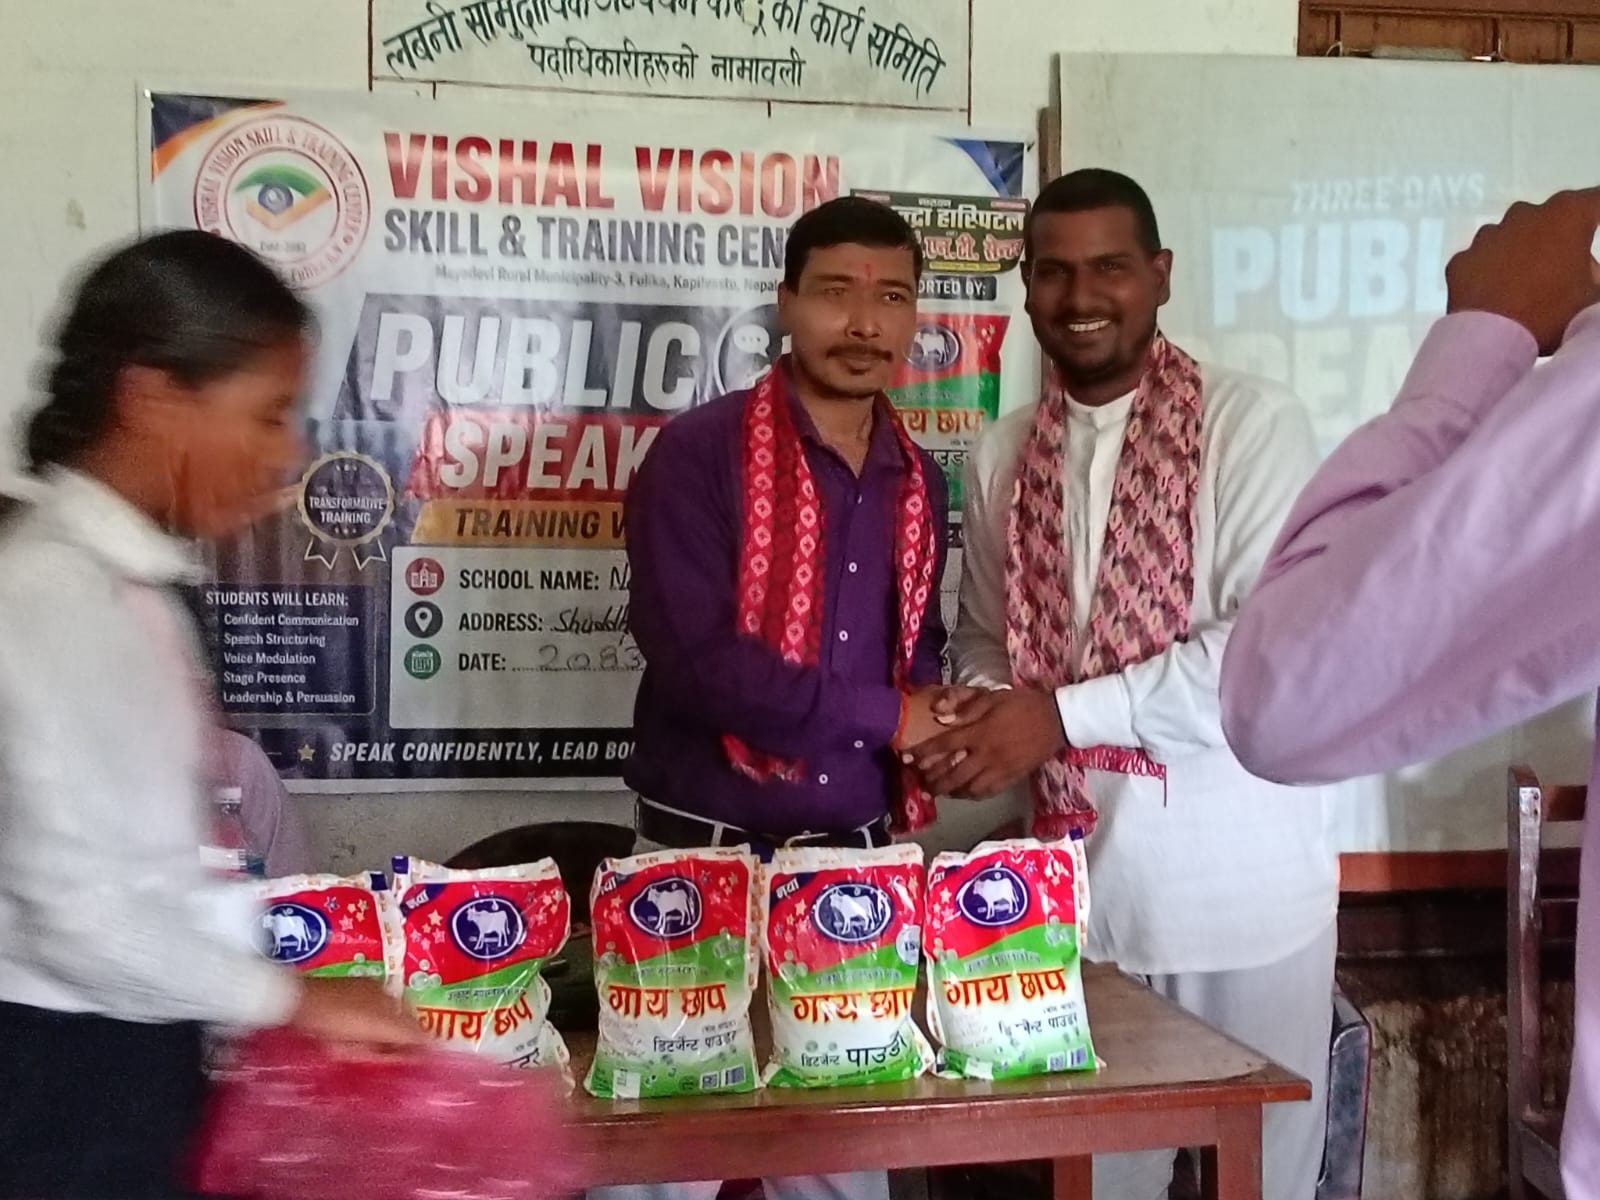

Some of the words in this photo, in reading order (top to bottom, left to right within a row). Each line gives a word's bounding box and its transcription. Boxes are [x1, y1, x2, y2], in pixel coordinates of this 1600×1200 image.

[811, 2, 866, 54] कार्य
[711, 46, 806, 88] नामावली
[383, 131, 615, 209] VISHAL
[635, 146, 840, 220] VISION
[1290, 176, 1393, 214] THREE
[1404, 172, 1486, 210] DAYS
[384, 209, 487, 256] SKILL
[500, 215, 527, 258] &
[537, 217, 706, 266] TRAINING
[717, 224, 791, 269] CEN
[370, 311, 701, 411] PUBLIC
[309, 495, 385, 510] TRANSFORMATIVE
[320, 511, 371, 524] TRAINING
[456, 508, 602, 539] TRAINING
[459, 569, 534, 590] SCHOOL
[540, 570, 599, 591] NAME:
[206, 591, 269, 606] STUDENTS
[272, 592, 302, 606] WILL
[305, 592, 349, 607] LEARN:
[224, 613, 275, 626] Confident
[278, 613, 359, 627] Communication
[459, 612, 543, 632] ADDRESS:
[224, 632, 263, 647] Speech
[266, 632, 326, 647] Structuring
[224, 652, 253, 665] Voice
[256, 652, 316, 665] Modulation
[459, 653, 506, 672] DATE:
[223, 671, 254, 686] Stage
[256, 671, 306, 684] Presence
[223, 691, 283, 706] Leadership
[285, 691, 294, 703] &
[297, 692, 356, 704] Persuasion
[329, 742, 396, 762] SPEAK
[402, 741, 543, 764] CONFIDENTLY,
[551, 742, 599, 761] LEAD
[605, 741, 636, 761] BO
[942, 973, 1012, 1008] गाय
[1017, 967, 1067, 1000] छाप
[608, 983, 674, 1020] गाय
[679, 982, 727, 1018] छाप
[790, 992, 862, 1024] गाय
[416, 1006, 488, 1041] गाय
[494, 991, 533, 1036] छाप
